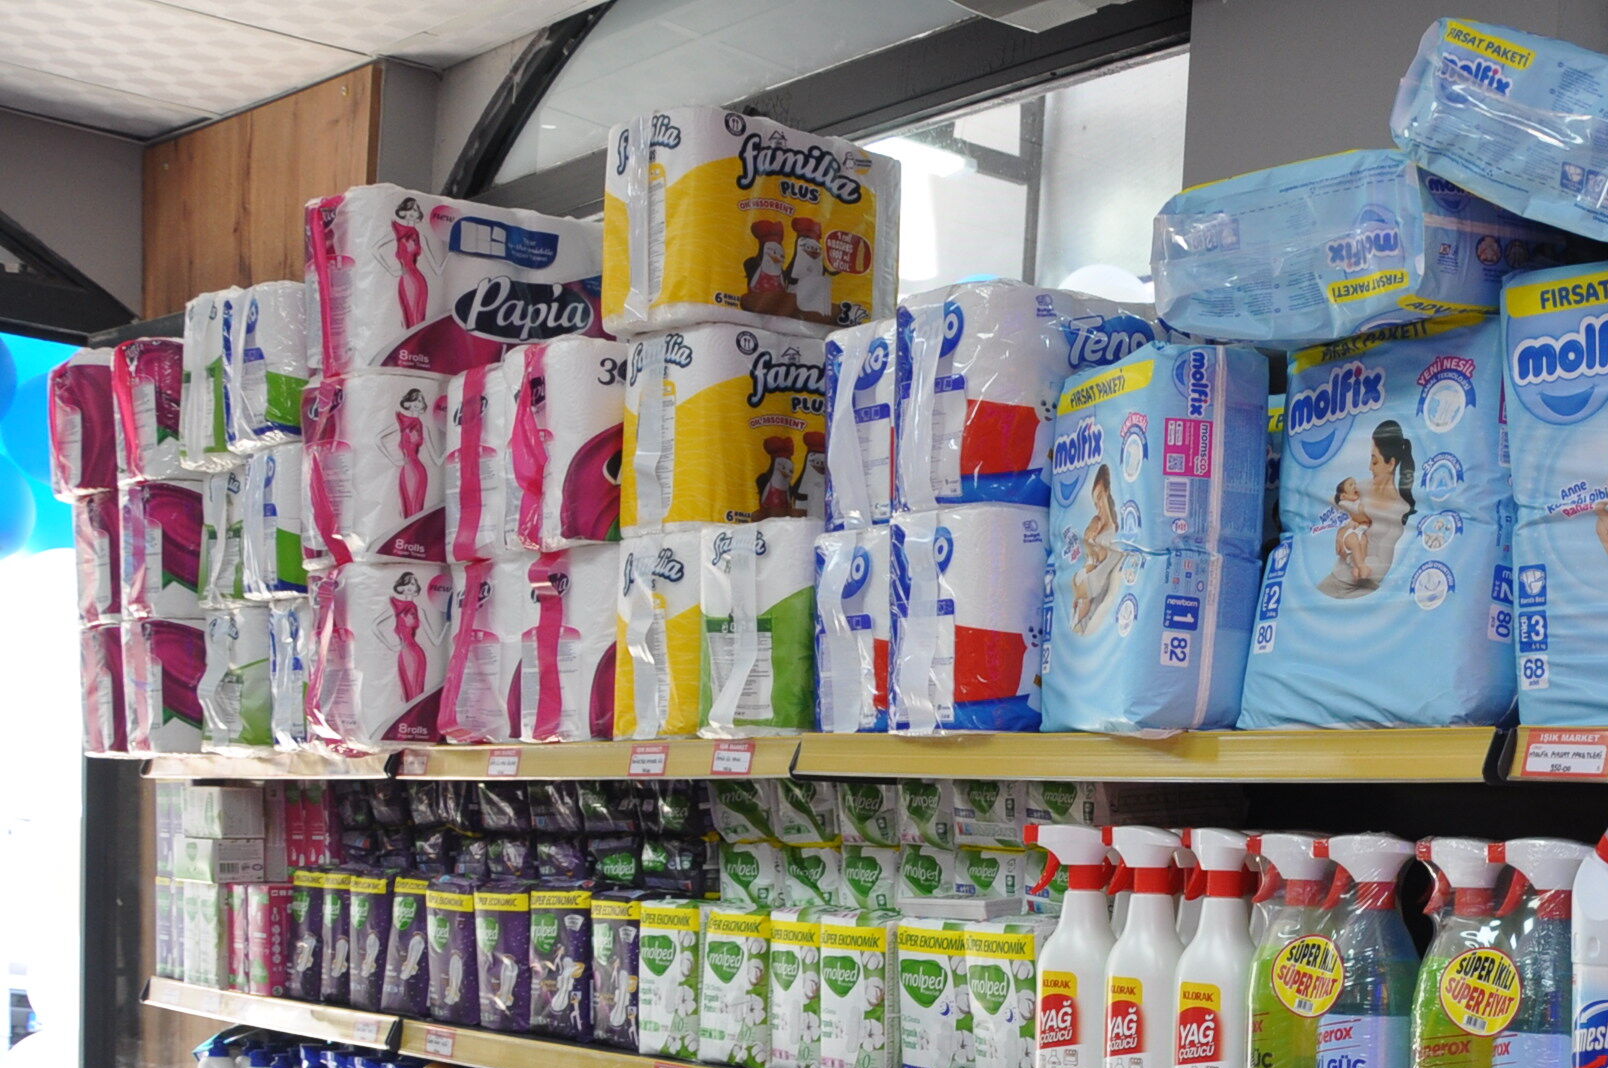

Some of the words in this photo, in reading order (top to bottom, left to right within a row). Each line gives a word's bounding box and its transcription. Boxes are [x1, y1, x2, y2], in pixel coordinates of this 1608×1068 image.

[738, 133, 861, 202] familia
[780, 181, 821, 202] PLUS
[471, 275, 589, 339] Papia
[1418, 358, 1442, 384] YENİ
[1442, 356, 1475, 378] NESİL
[1560, 481, 1588, 501] Anne
[1268, 585, 1279, 611] 2
[1257, 625, 1274, 645] 80
[1529, 618, 1545, 642] 3
[1169, 637, 1188, 662] 82
[1523, 658, 1545, 679] 68
[1540, 734, 1563, 746] IŞIK
[1564, 734, 1600, 747] MARKET
[708, 950, 743, 973] molped
[1286, 941, 1315, 964] SÜPER
[1316, 947, 1336, 974] İKİLİ
[822, 965, 859, 987] molped
[1276, 963, 1313, 986] SÜPER
[1312, 971, 1338, 1000] FİYAT
[969, 977, 1009, 999] molped
[1179, 1014, 1215, 1045] YAĞ
[1179, 1042, 1215, 1063] ÇÖZÜCÜ
